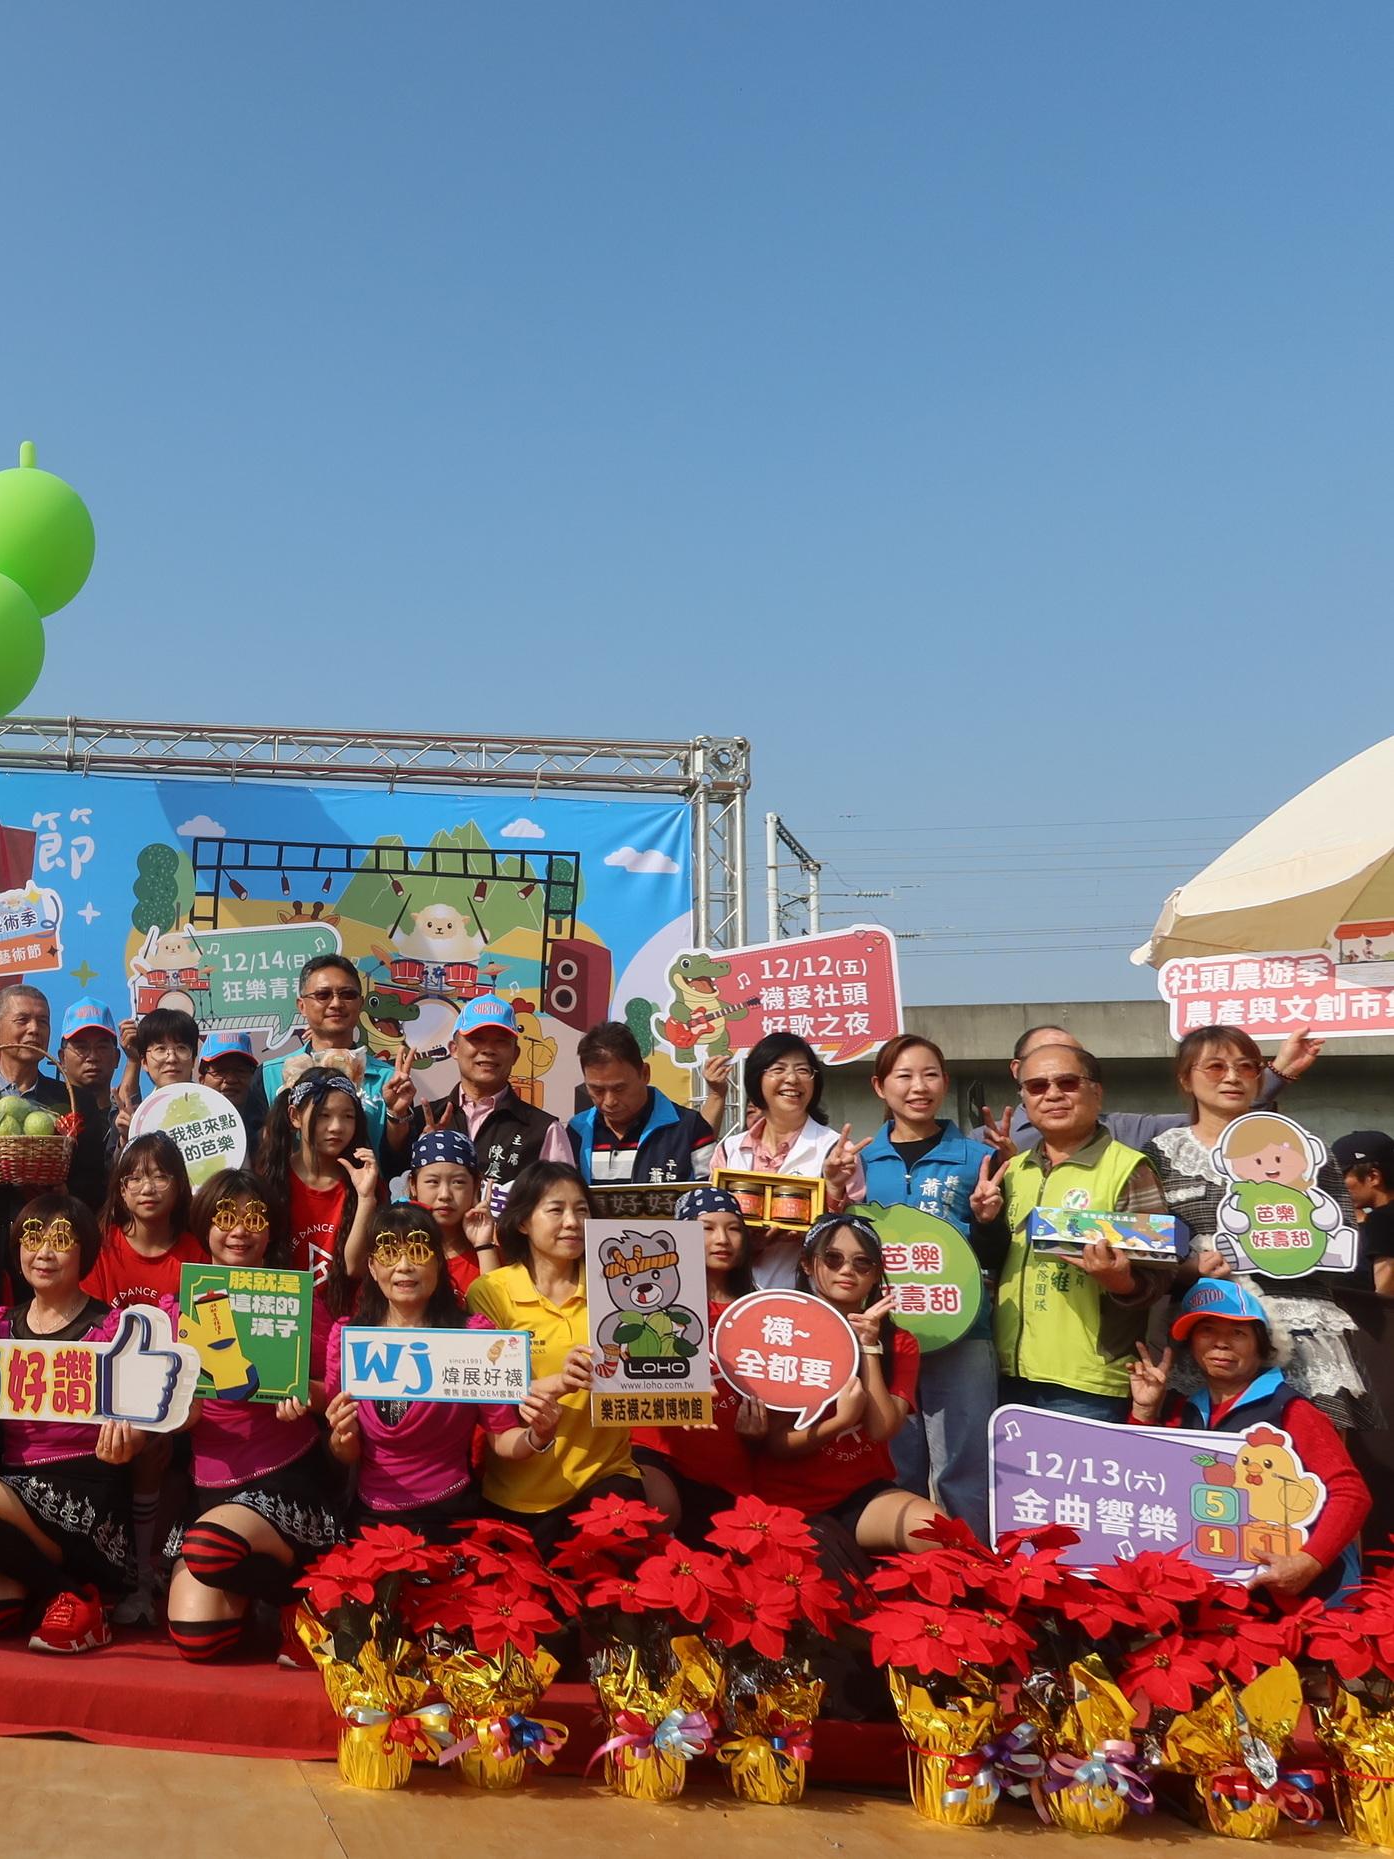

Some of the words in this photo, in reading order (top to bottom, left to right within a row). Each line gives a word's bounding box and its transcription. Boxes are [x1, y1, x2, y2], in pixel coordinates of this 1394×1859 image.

[760, 955, 867, 981] 12/12(五)
[1168, 957, 1329, 996] 社頭農遊季
[759, 982, 869, 1011] 襪愛社頭
[761, 1010, 871, 1038] 好歌之夜
[169, 1112, 238, 1143] 我想來點
[180, 1134, 236, 1162] 的芭樂
[1255, 1204, 1296, 1223] 芭樂
[299, 1223, 335, 1240] DANCE
[1251, 1230, 1311, 1248] 妖壽甜
[880, 1245, 940, 1272] 芭樂
[119, 1286, 158, 1300] DANCE
[228, 1270, 301, 1294] 朕就是
[228, 1293, 301, 1316] 這樣的
[879, 1284, 959, 1312] 壽甜
[251, 1317, 299, 1338] 漢子
[442, 1366, 524, 1387] 煒展好襪
[628, 1362, 686, 1374] LOHO
[734, 1348, 833, 1390] 全都要
[620, 1381, 695, 1391] www.loho.com.tw
[601, 1397, 703, 1421] 樂活襪之鄉博物館
[1023, 1449, 1167, 1496] 12/13(六)
[1011, 1486, 1179, 1543] 金曲響樂
[1205, 1492, 1227, 1518] 5
[1207, 1529, 1224, 1554] 1
